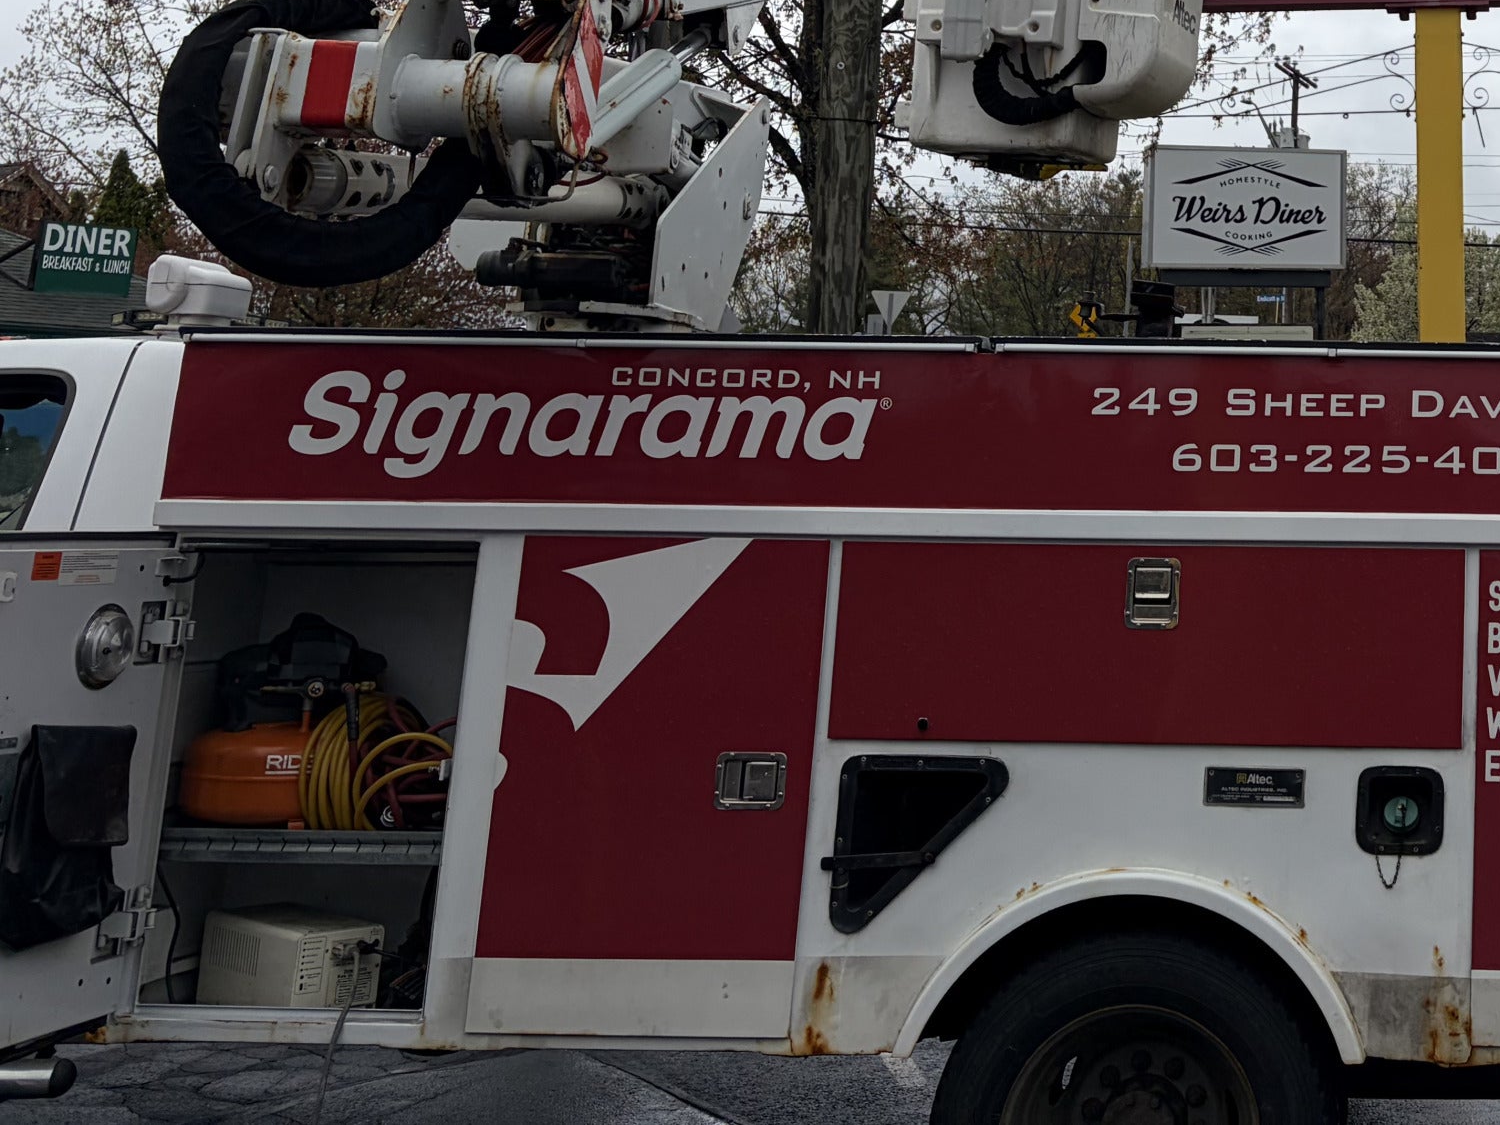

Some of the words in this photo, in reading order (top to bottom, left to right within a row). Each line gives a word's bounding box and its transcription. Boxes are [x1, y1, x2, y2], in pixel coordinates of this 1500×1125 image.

[1219, 176, 1281, 190] HOMESTYLE
[1172, 195, 1248, 224] Weirs
[1251, 196, 1328, 225] Diner
[42, 223, 132, 258] DINER
[1224, 230, 1273, 242] COOKING
[42, 254, 93, 273] BREAKFAST
[103, 259, 131, 275] LUNCH
[611, 366, 812, 392] CONCORD,
[829, 369, 882, 391] NH
[1091, 387, 1199, 417] 249
[1225, 388, 1387, 418] SHEEP
[288, 368, 883, 479] Signarama
[266, 754, 313, 770] RID
[1246, 773, 1273, 785] Altec
